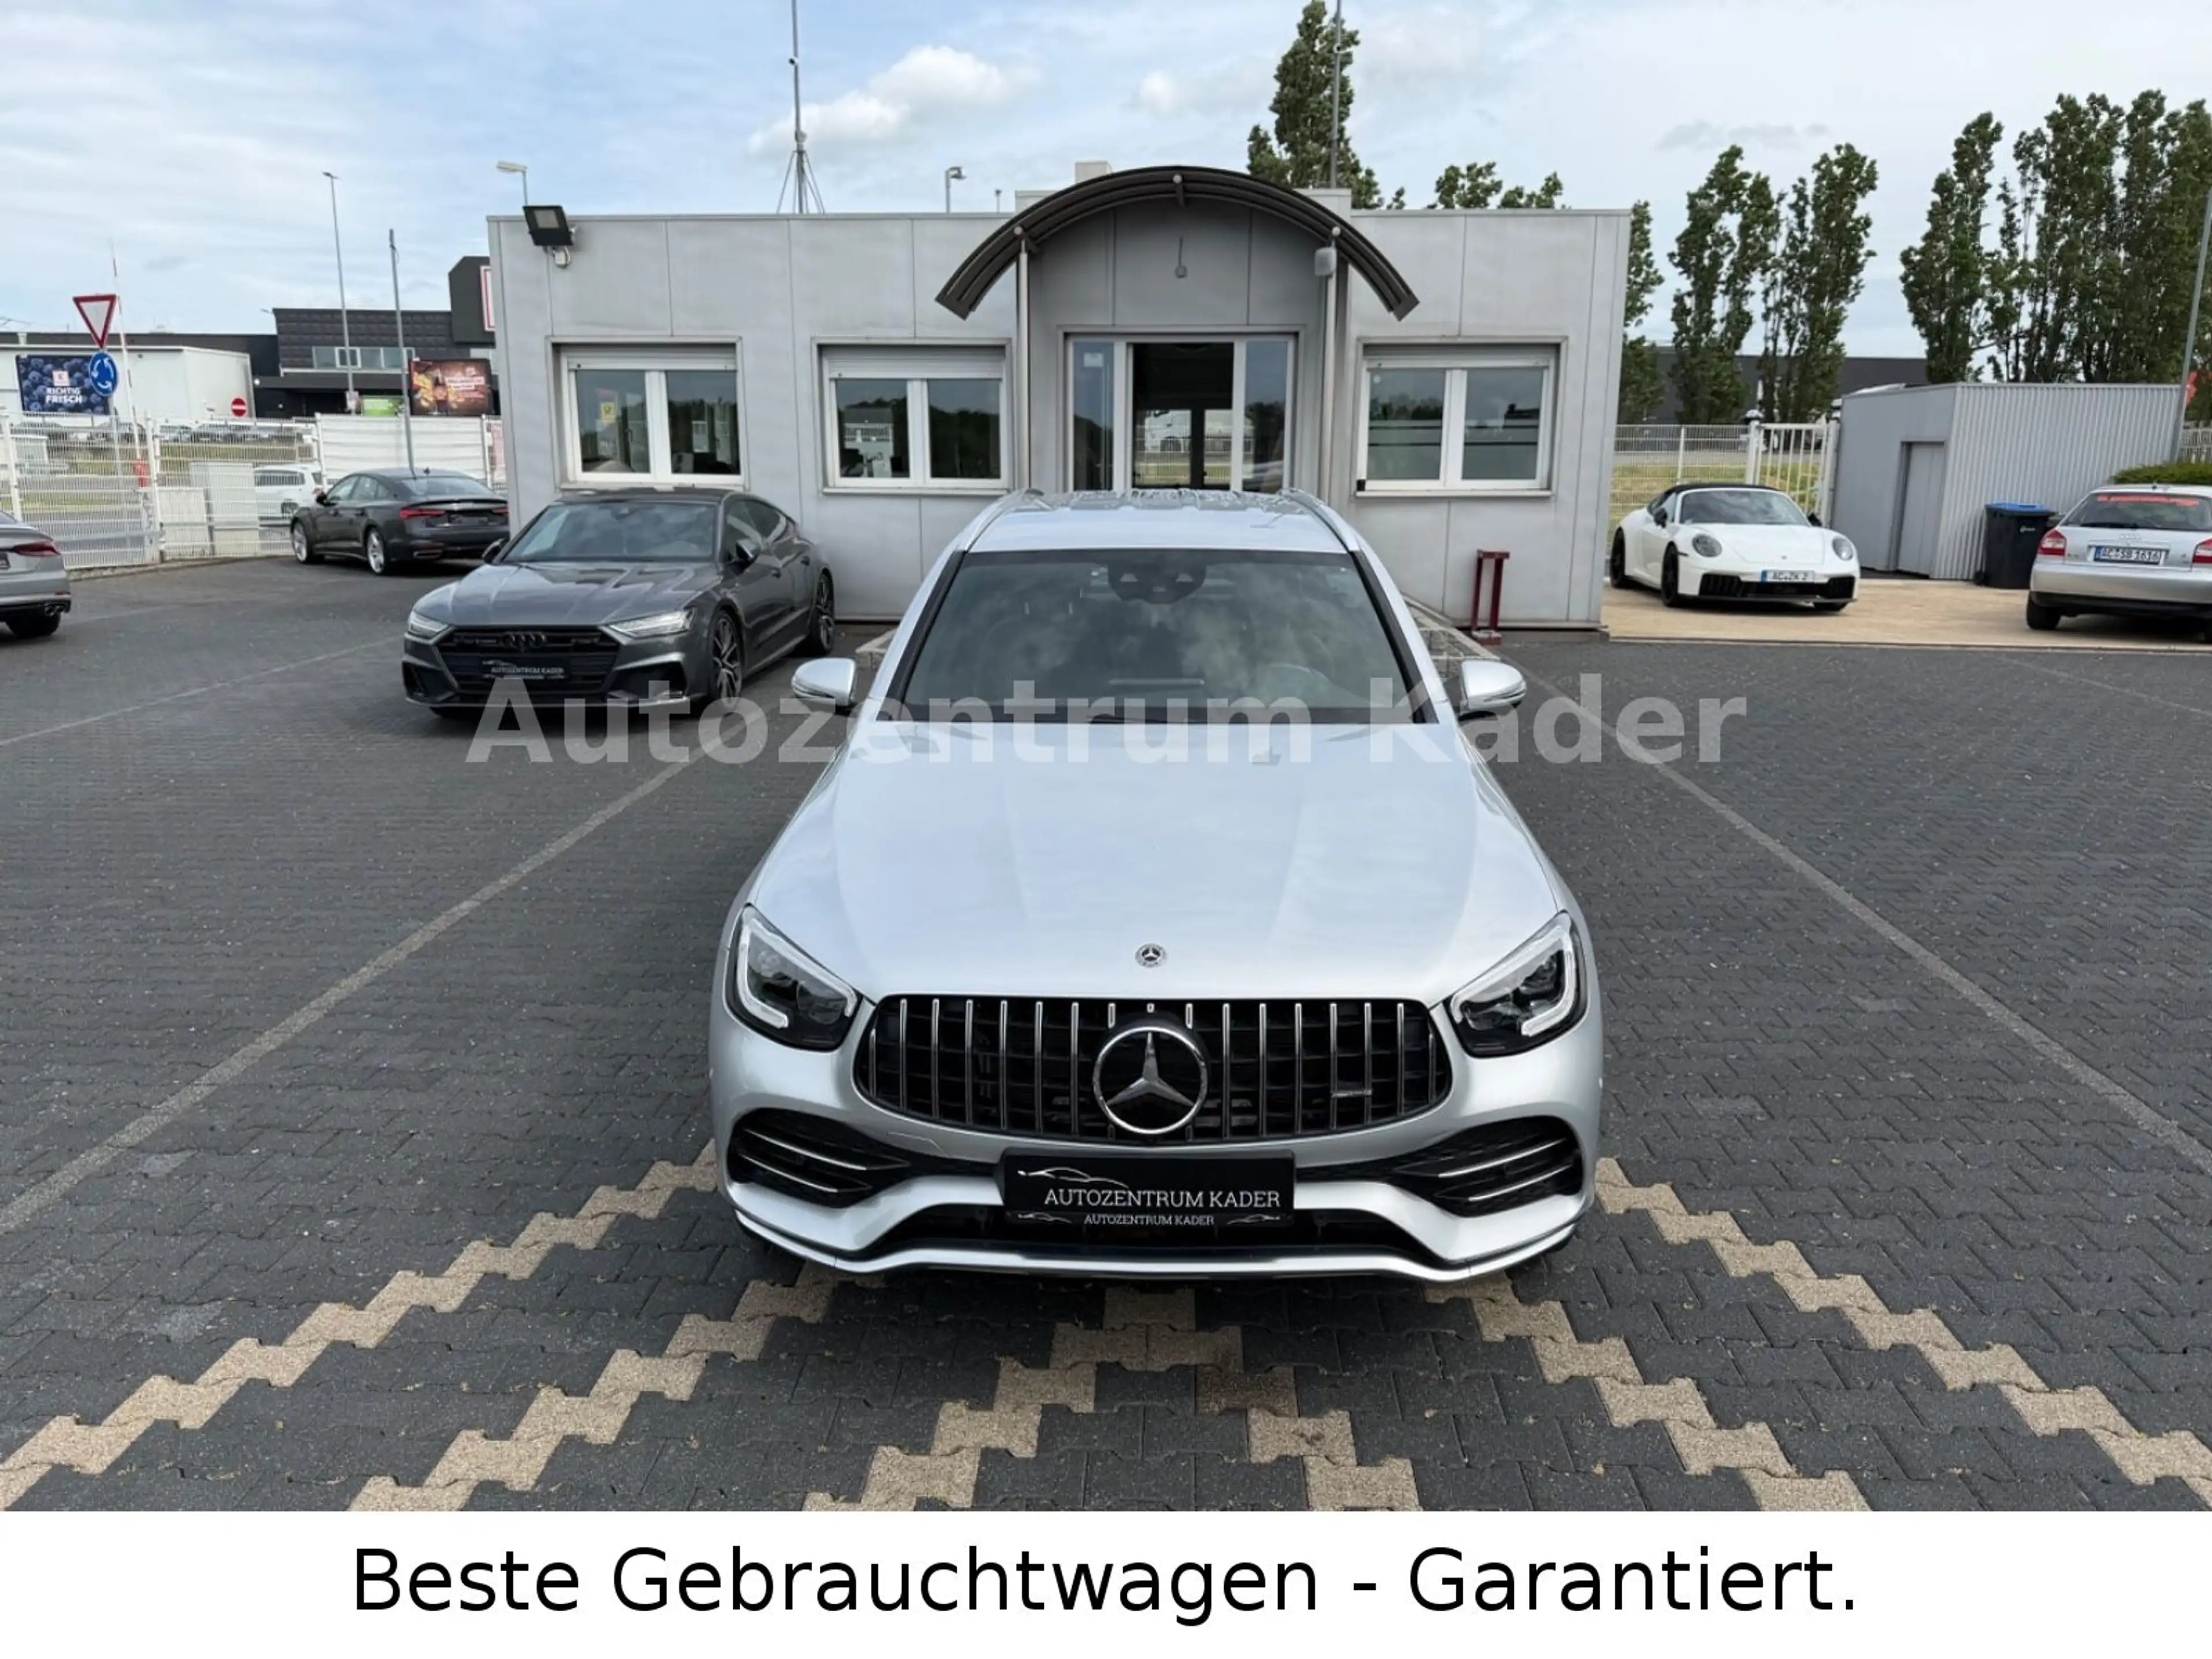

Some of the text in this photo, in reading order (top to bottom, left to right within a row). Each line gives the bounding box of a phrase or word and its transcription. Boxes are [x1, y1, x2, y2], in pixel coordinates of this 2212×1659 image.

[46, 395, 82, 403] FRISCH
[1044, 1188, 1281, 1208] AUTOZENTRUM KADER
[1084, 1214, 1215, 1226] AUTOZENTRUM KADER
